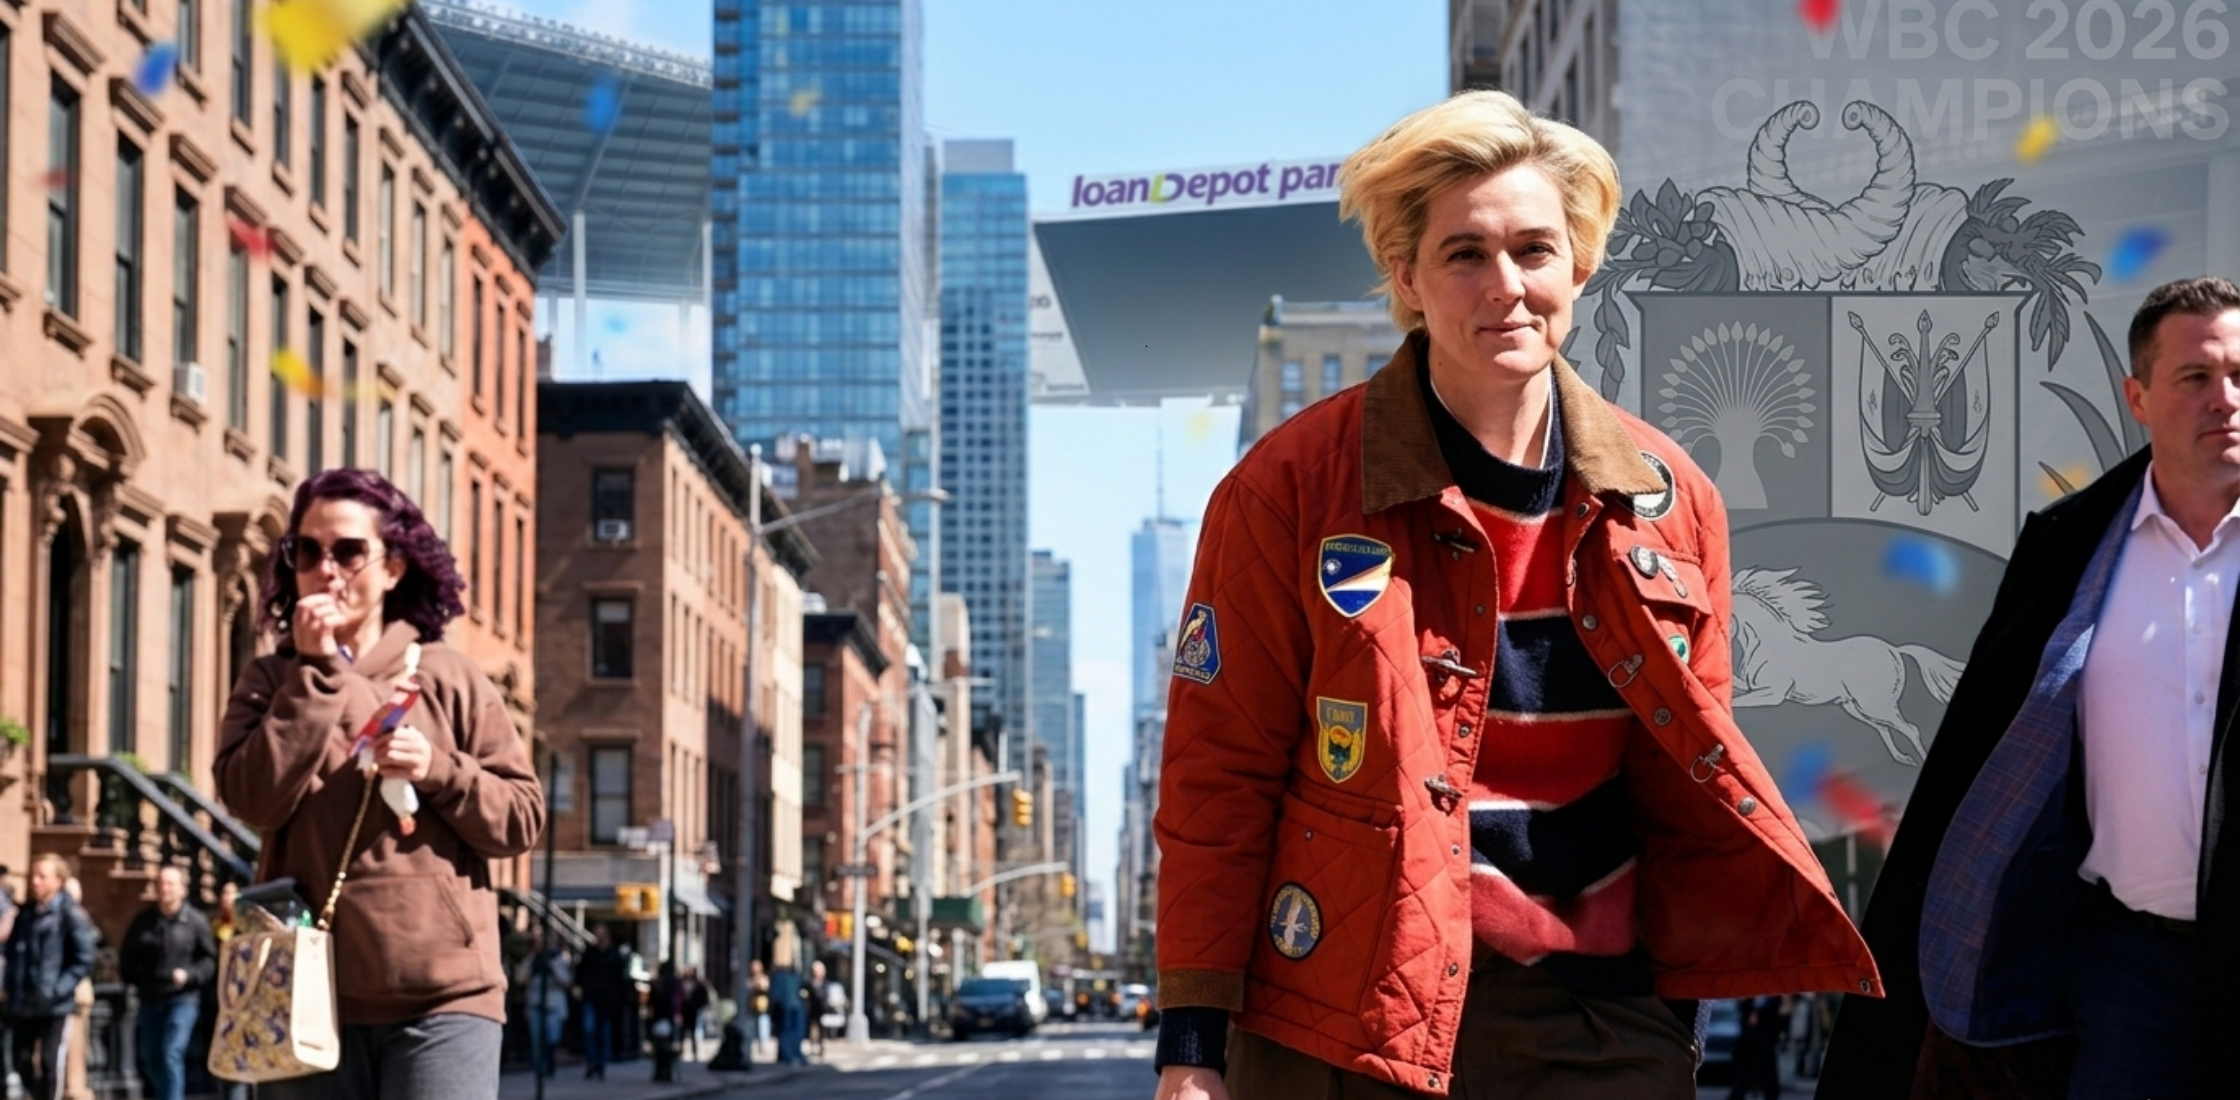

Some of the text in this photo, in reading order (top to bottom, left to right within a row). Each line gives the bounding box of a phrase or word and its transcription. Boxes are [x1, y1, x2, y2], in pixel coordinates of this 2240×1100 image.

[1802, 0, 2230, 60] WBC 2026
[1071, 163, 1271, 207] loanDepot
